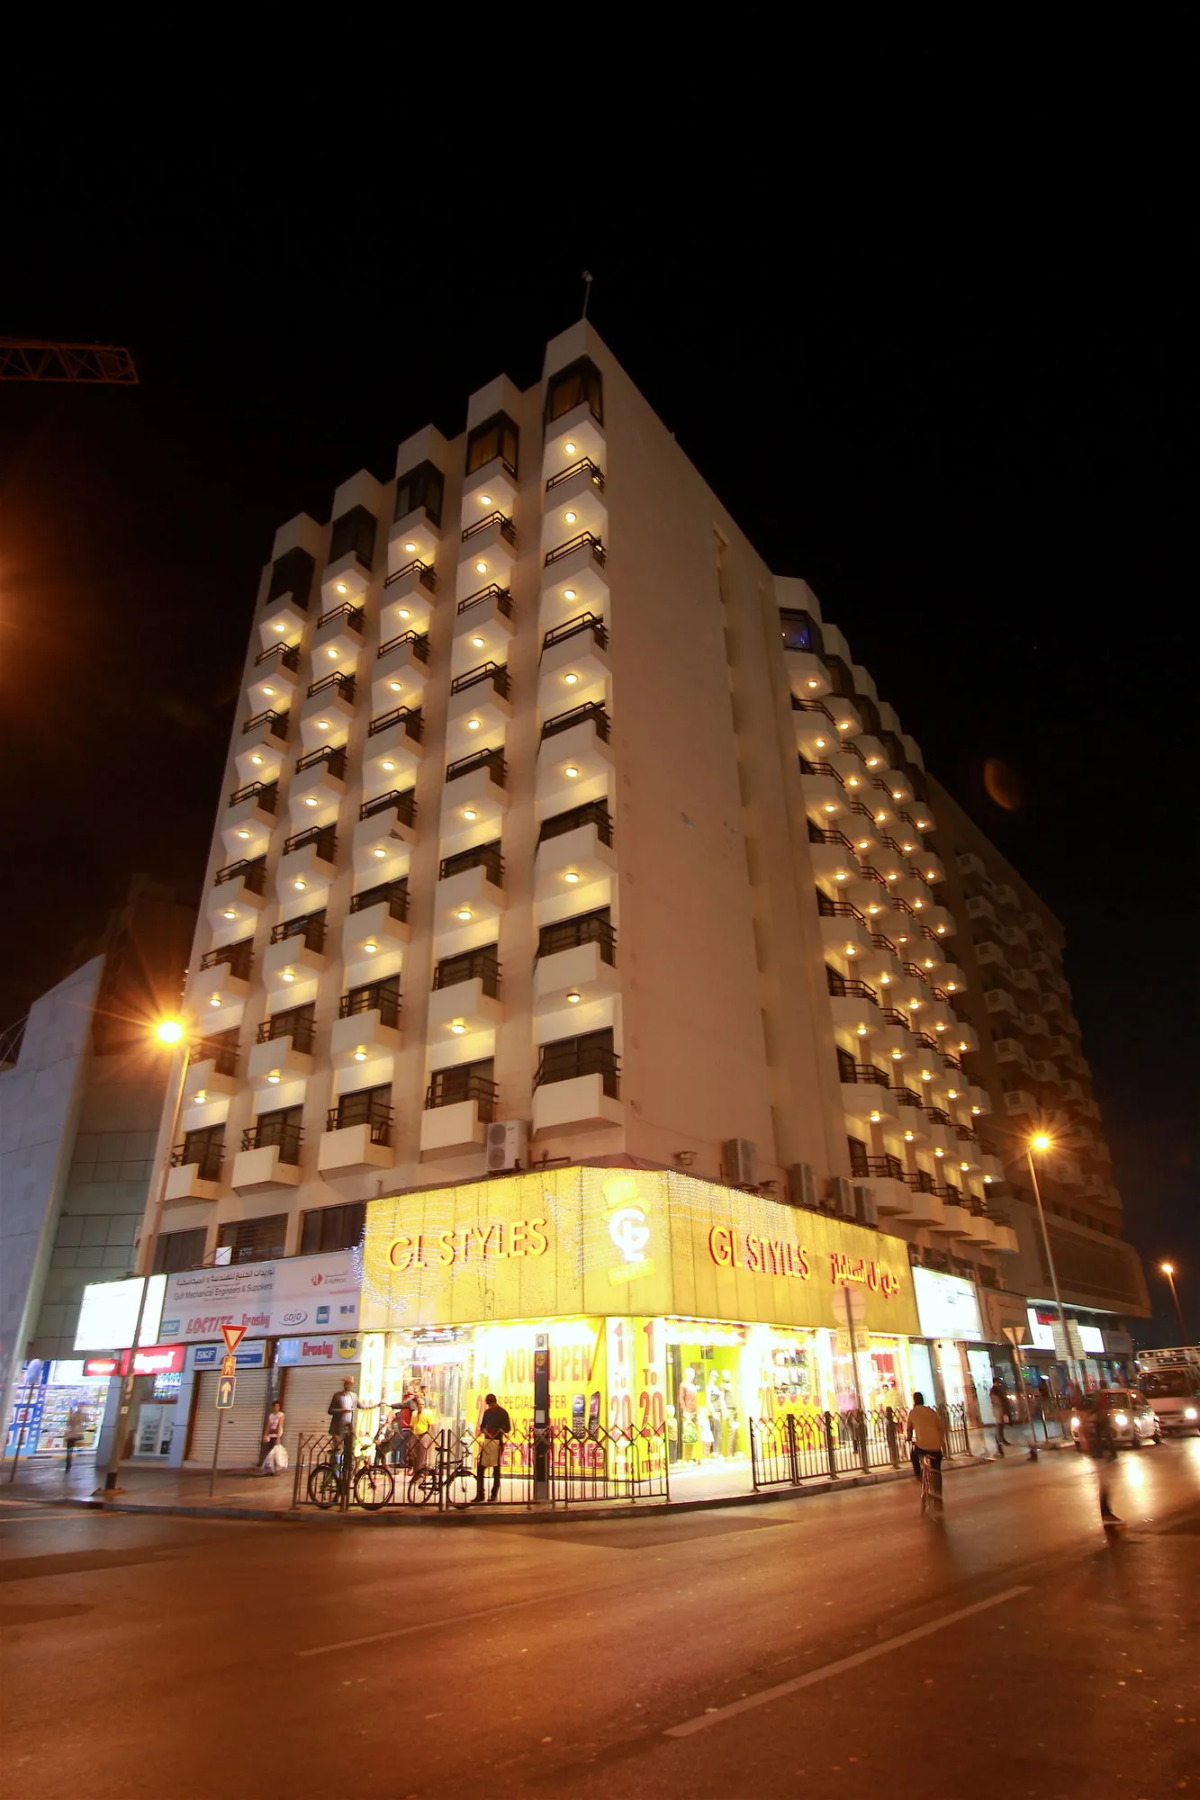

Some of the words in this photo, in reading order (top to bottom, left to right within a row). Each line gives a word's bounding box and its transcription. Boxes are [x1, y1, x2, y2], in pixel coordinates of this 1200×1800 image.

[386, 1235, 428, 1271] GL
[438, 1217, 549, 1266] STYLES
[708, 1225, 744, 1268] GL
[746, 1233, 812, 1281] STYLES
[185, 1288, 214, 1300] Mechanical
[215, 1286, 241, 1297] Engineers
[247, 1283, 273, 1294] Suppliers
[196, 1350, 214, 1360] SKF
[643, 1320, 655, 1364] 1
[639, 1390, 663, 1438] 20
[569, 1442, 606, 1468] FREE
